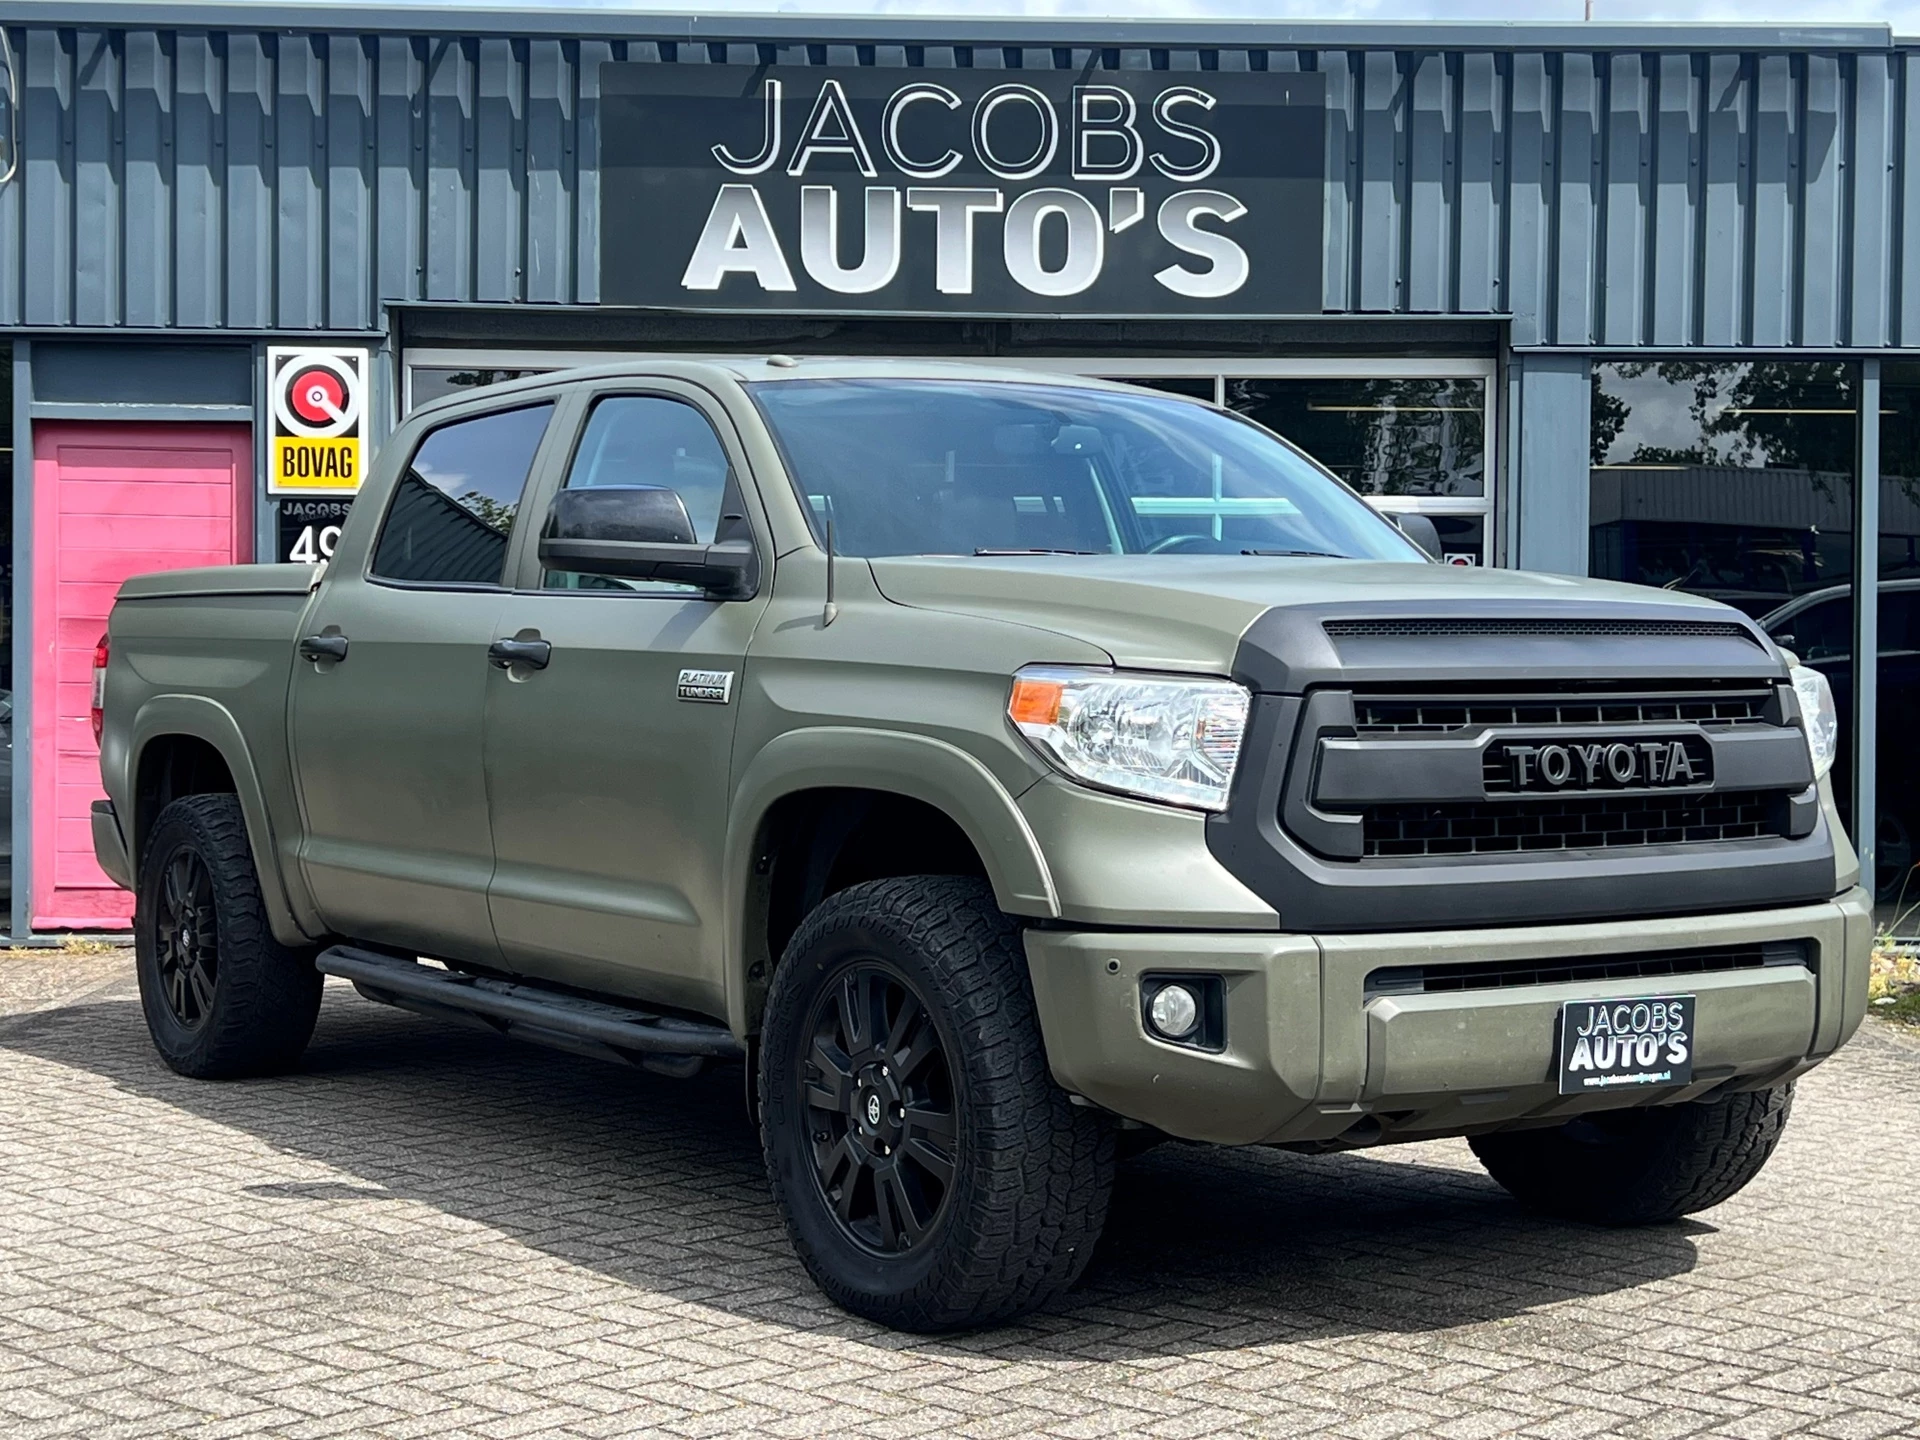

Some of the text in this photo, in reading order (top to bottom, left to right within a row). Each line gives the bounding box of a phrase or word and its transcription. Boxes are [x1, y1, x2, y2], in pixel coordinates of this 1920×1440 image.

[711, 79, 1221, 182] JACOBS
[681, 183, 1249, 298] AUTO'S
[283, 446, 352, 478] BOVAG
[282, 502, 352, 516] JACOBS
[680, 672, 727, 685] PLATINUM
[680, 686, 723, 699] TUNDRA
[1503, 741, 1695, 788] TOYOTA
[1576, 1002, 1684, 1036] JACOBS
[1568, 1031, 1688, 1072] AUTO'S
